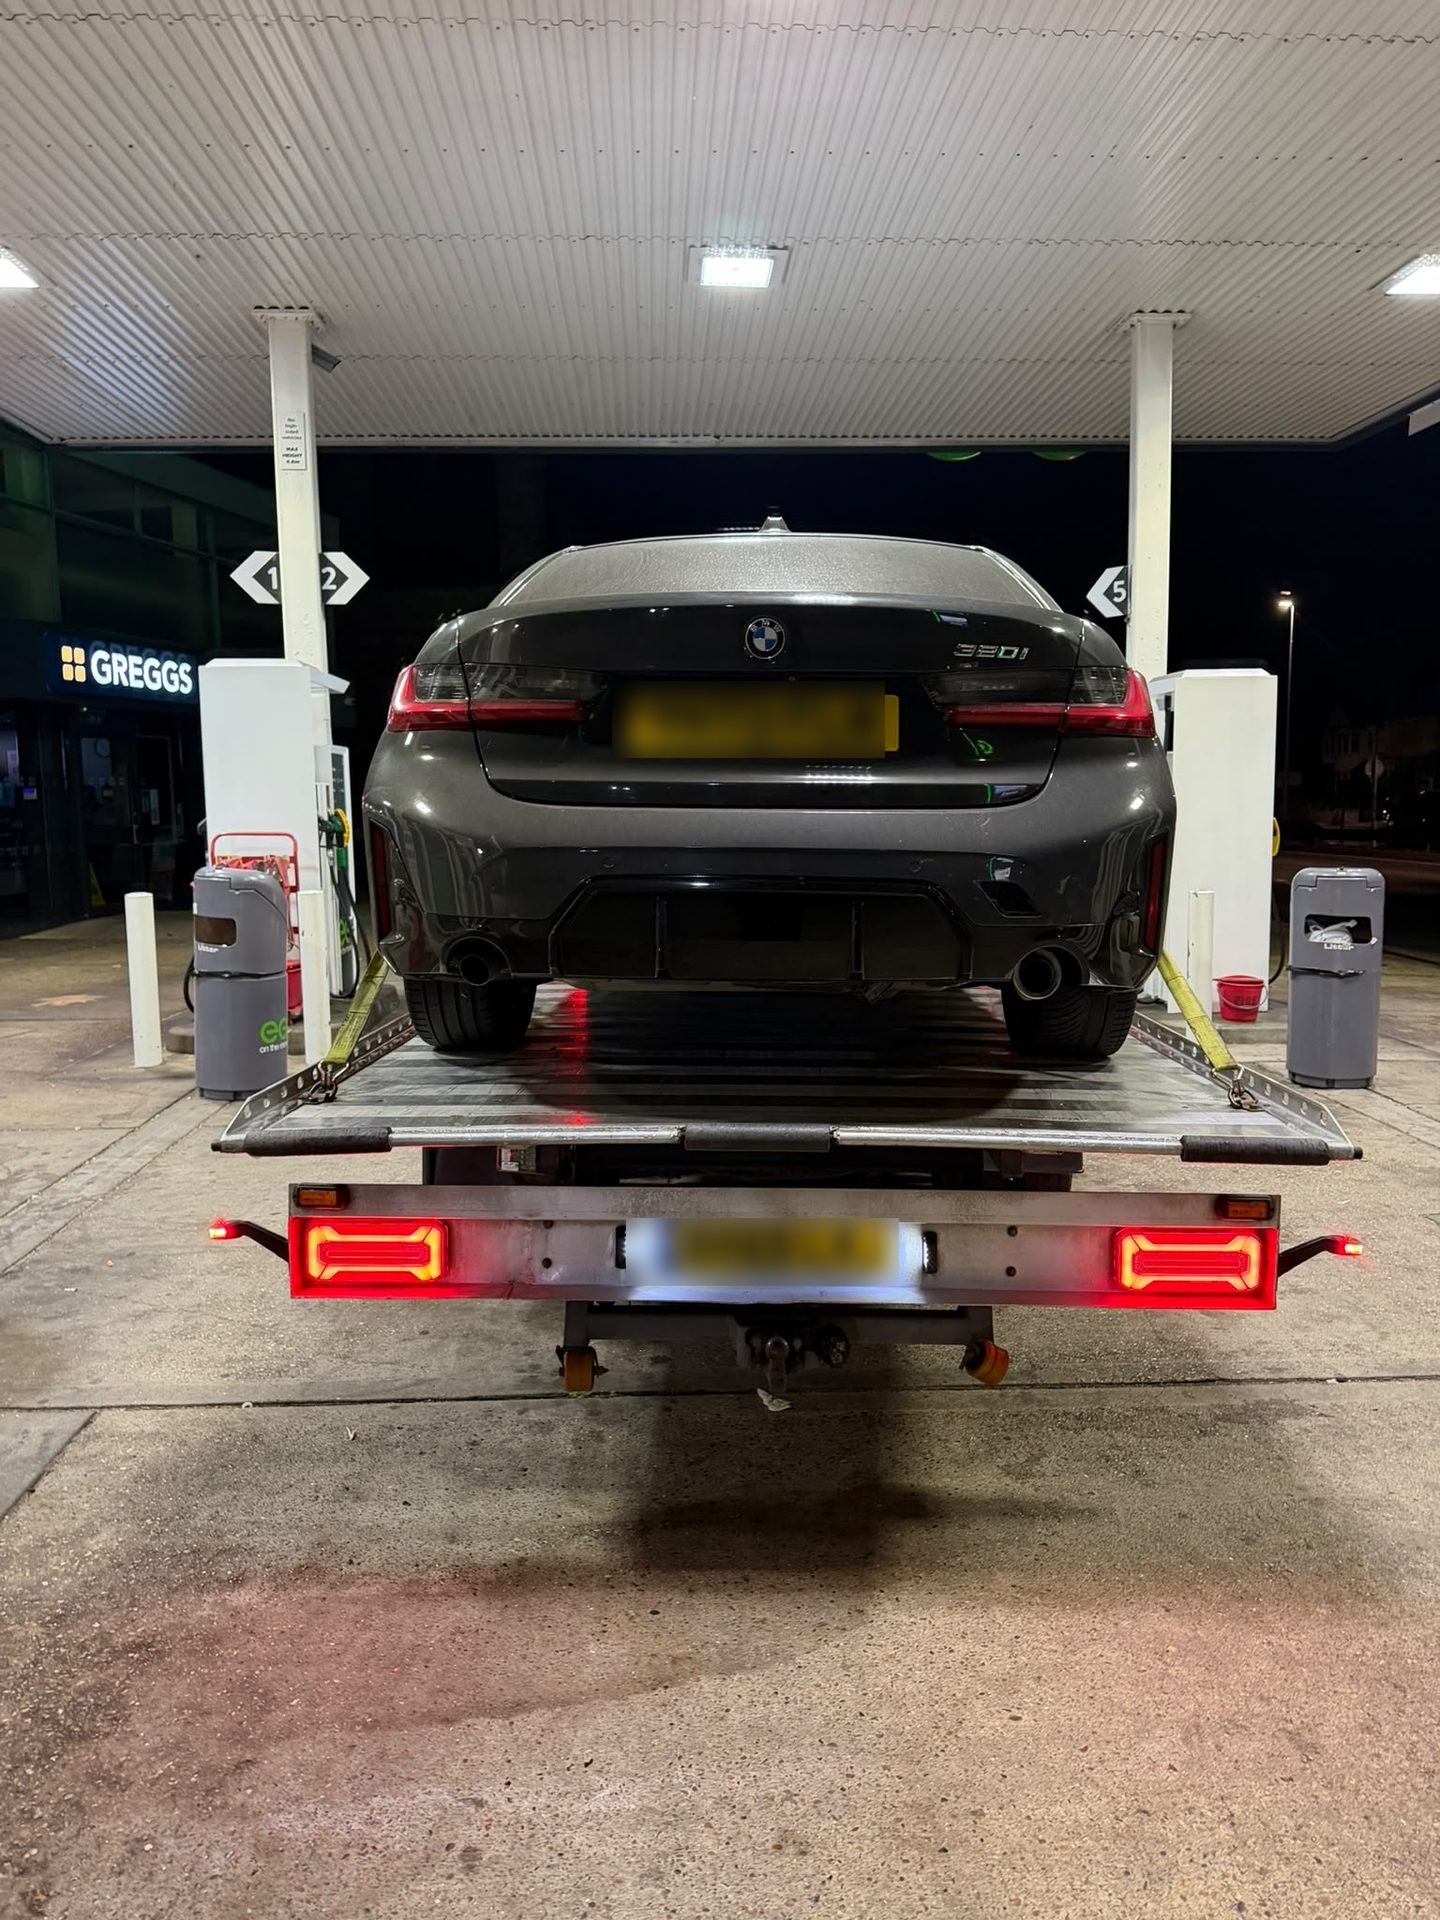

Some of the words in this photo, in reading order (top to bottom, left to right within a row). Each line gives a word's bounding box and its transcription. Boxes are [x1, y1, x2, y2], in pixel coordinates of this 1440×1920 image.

[267, 566, 278, 590] 1
[321, 566, 337, 590] 2
[1112, 579, 1127, 603] 5
[90, 649, 193, 695] GREGGS
